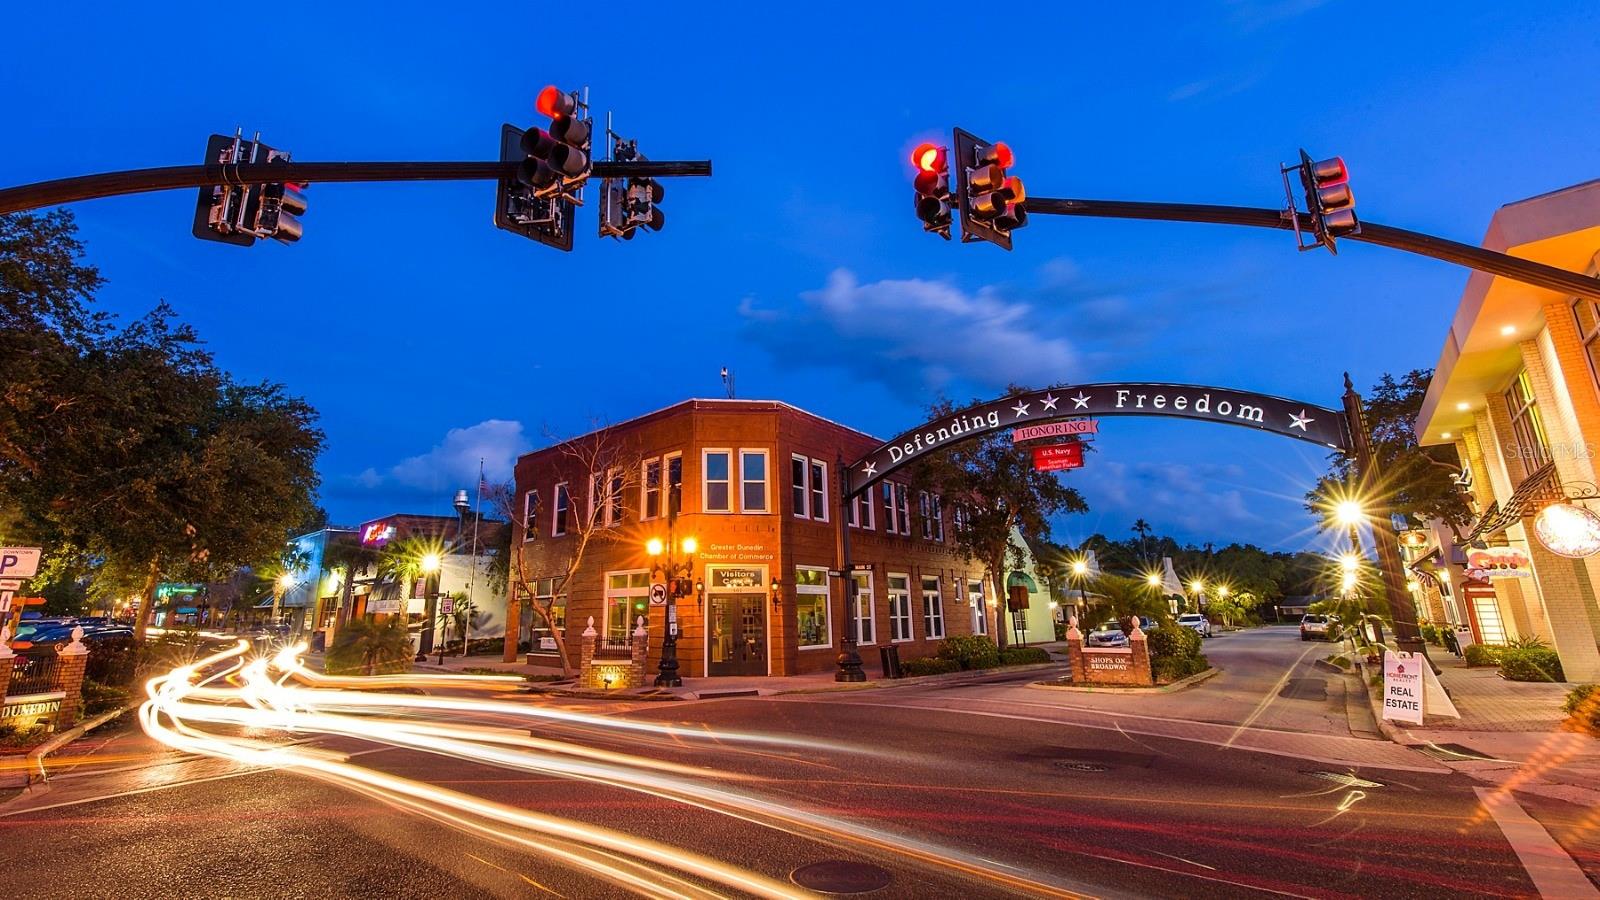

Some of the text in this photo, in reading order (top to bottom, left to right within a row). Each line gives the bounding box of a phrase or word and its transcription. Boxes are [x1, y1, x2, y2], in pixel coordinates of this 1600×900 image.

[887, 389, 1265, 464] Defending Freedom
[1022, 422, 1086, 438] HONORING
[1055, 448, 1071, 456] Navy
[0, 555, 18, 575] P
[1386, 672, 1418, 680] HOMEFRONT
[1390, 686, 1414, 697] REAL
[2, 701, 61, 718] DUNEDIN
[1386, 698, 1419, 711] ESTATE
